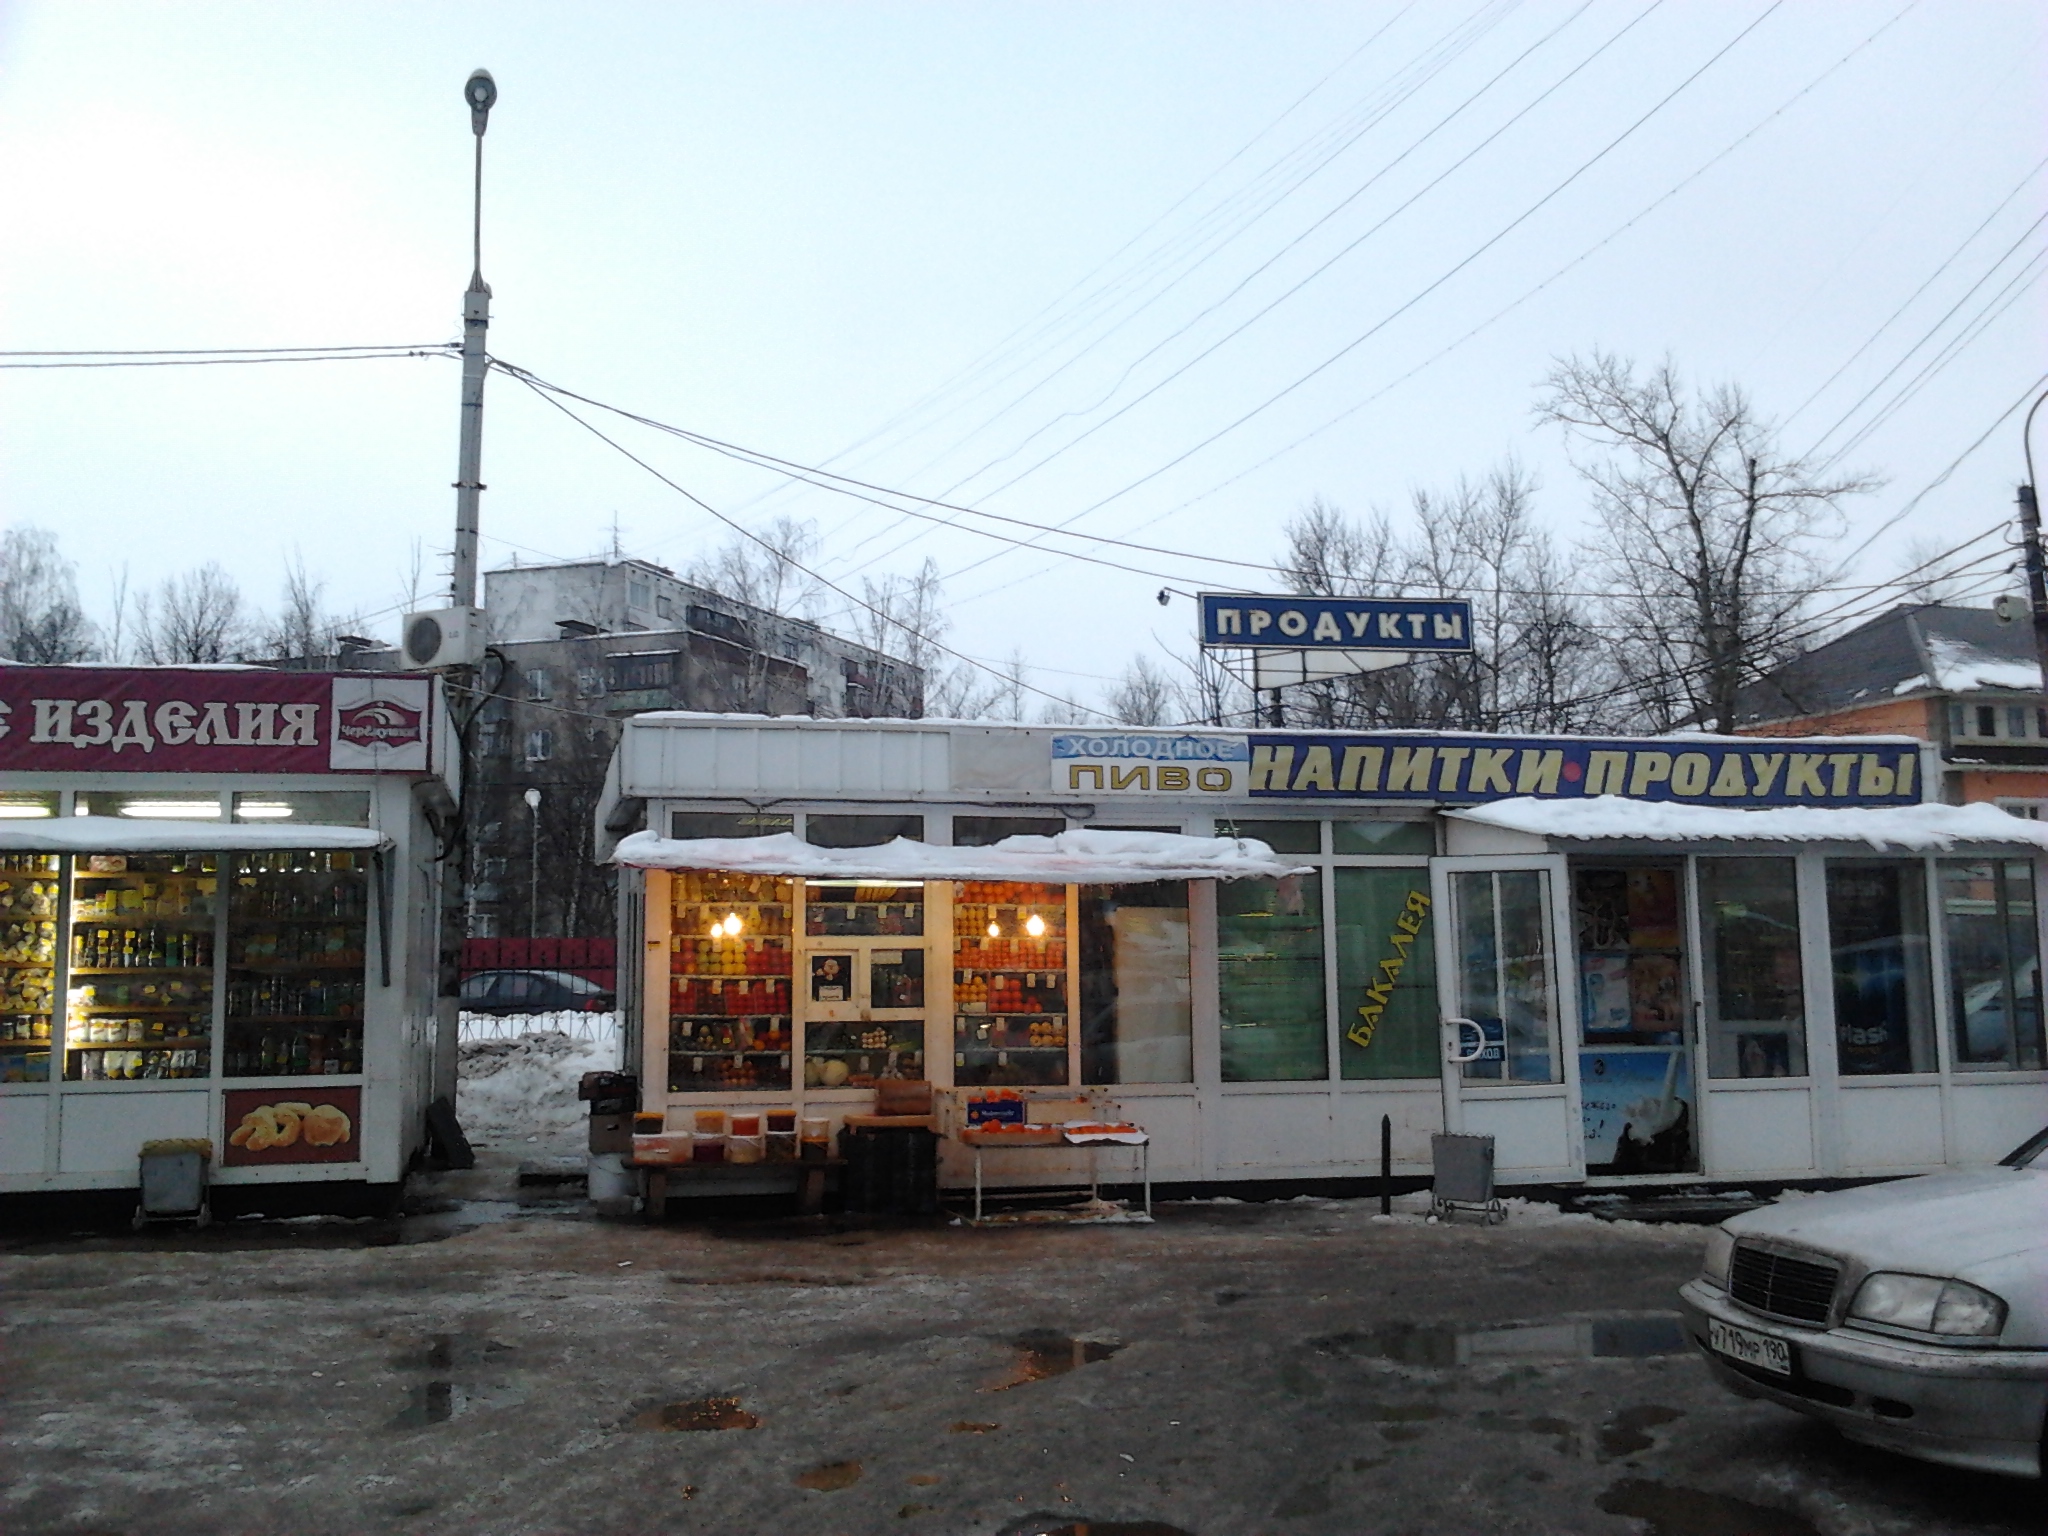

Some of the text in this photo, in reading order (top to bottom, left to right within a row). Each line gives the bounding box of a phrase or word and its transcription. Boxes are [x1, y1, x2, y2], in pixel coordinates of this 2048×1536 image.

[1215, 607, 1463, 642] ПРОДУКТЫ
[29, 699, 320, 753] ИЗДЕЛИЯ
[1067, 738, 1234, 759] ХОЛОДНОЕ
[1250, 744, 1915, 797] НАПИТКИ ПРОДУКТЫ
[1069, 765, 1232, 791] ПИВО
[1347, 890, 1431, 1048] БАКАЛЕЯ
